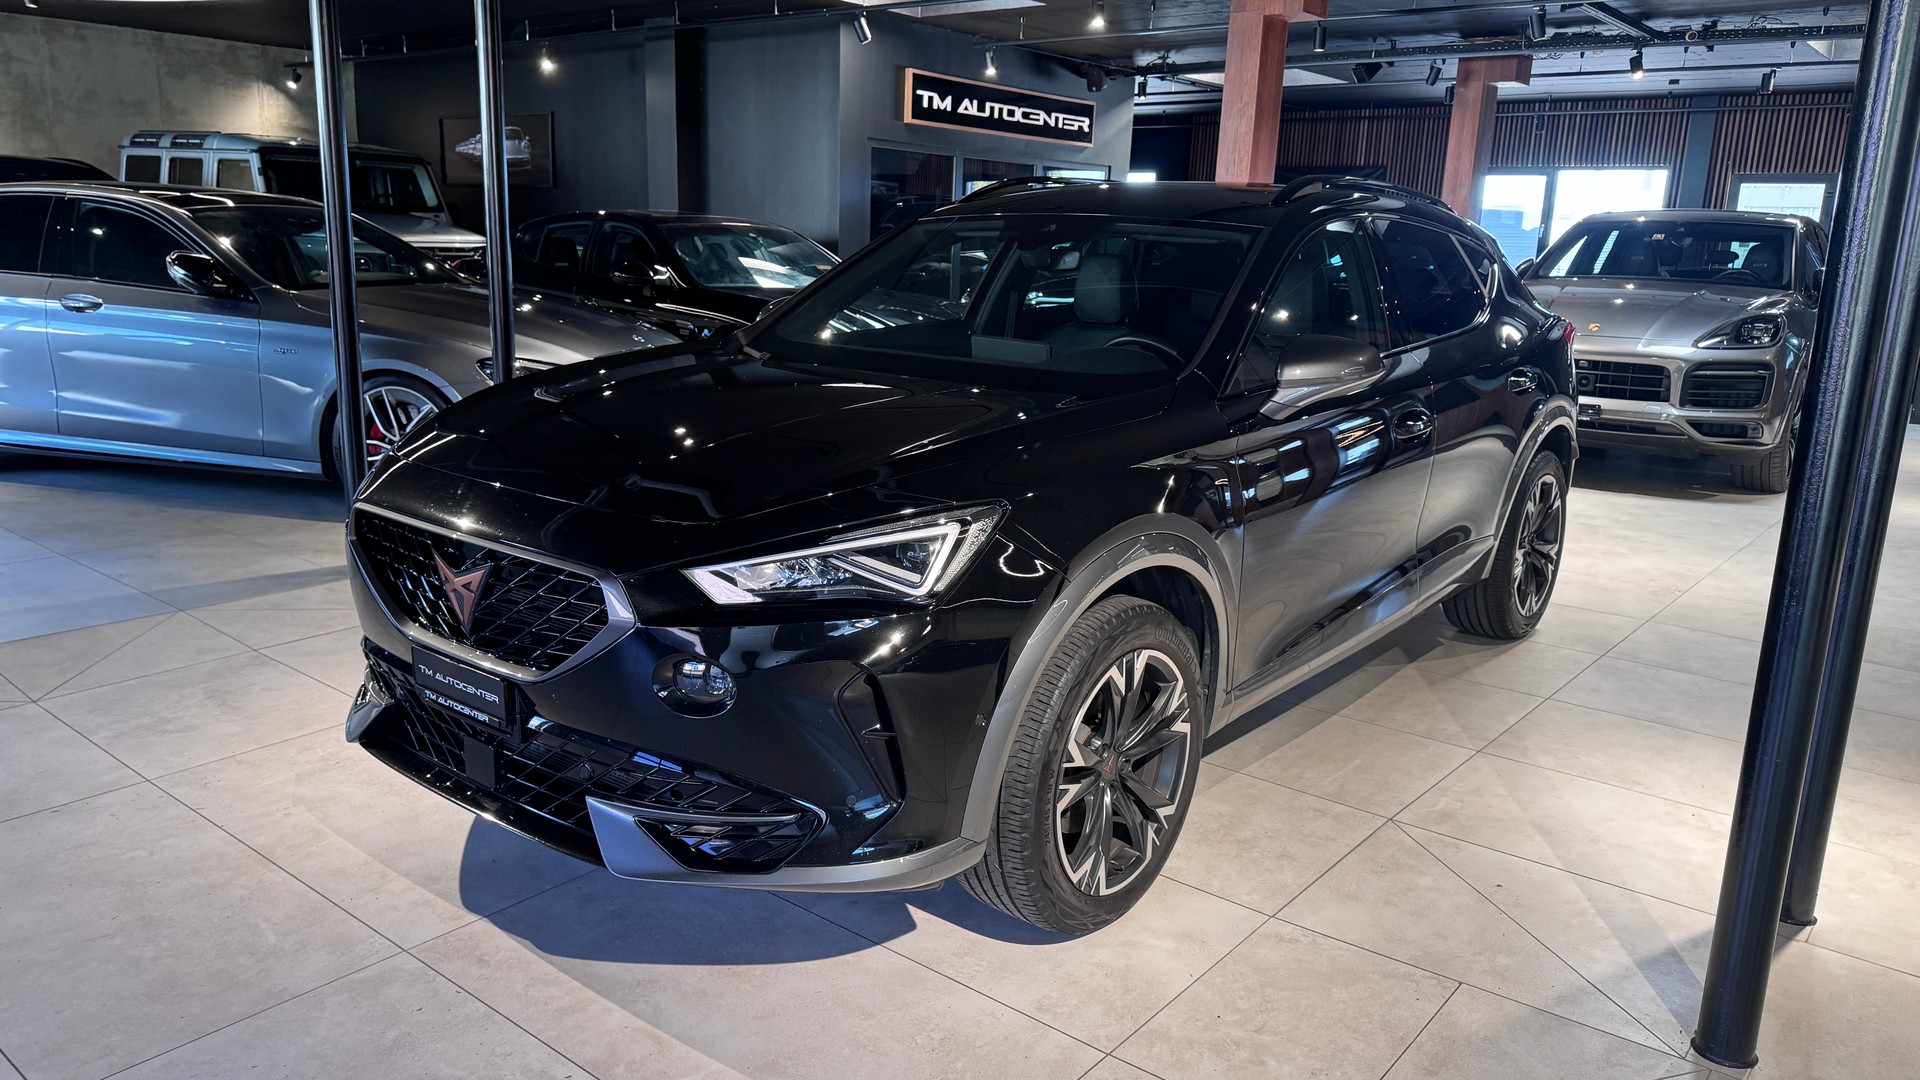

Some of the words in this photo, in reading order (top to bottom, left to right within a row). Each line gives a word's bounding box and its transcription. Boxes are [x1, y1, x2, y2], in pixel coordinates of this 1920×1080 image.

[915, 89, 952, 112] TM
[957, 98, 1090, 133] AUTOCENTER
[1154, 622, 1195, 666] Continental
[418, 665, 433, 676] TM
[435, 673, 499, 704] AUTOCENTER
[424, 690, 436, 700] TM
[438, 697, 489, 723] AUTOCENTER
